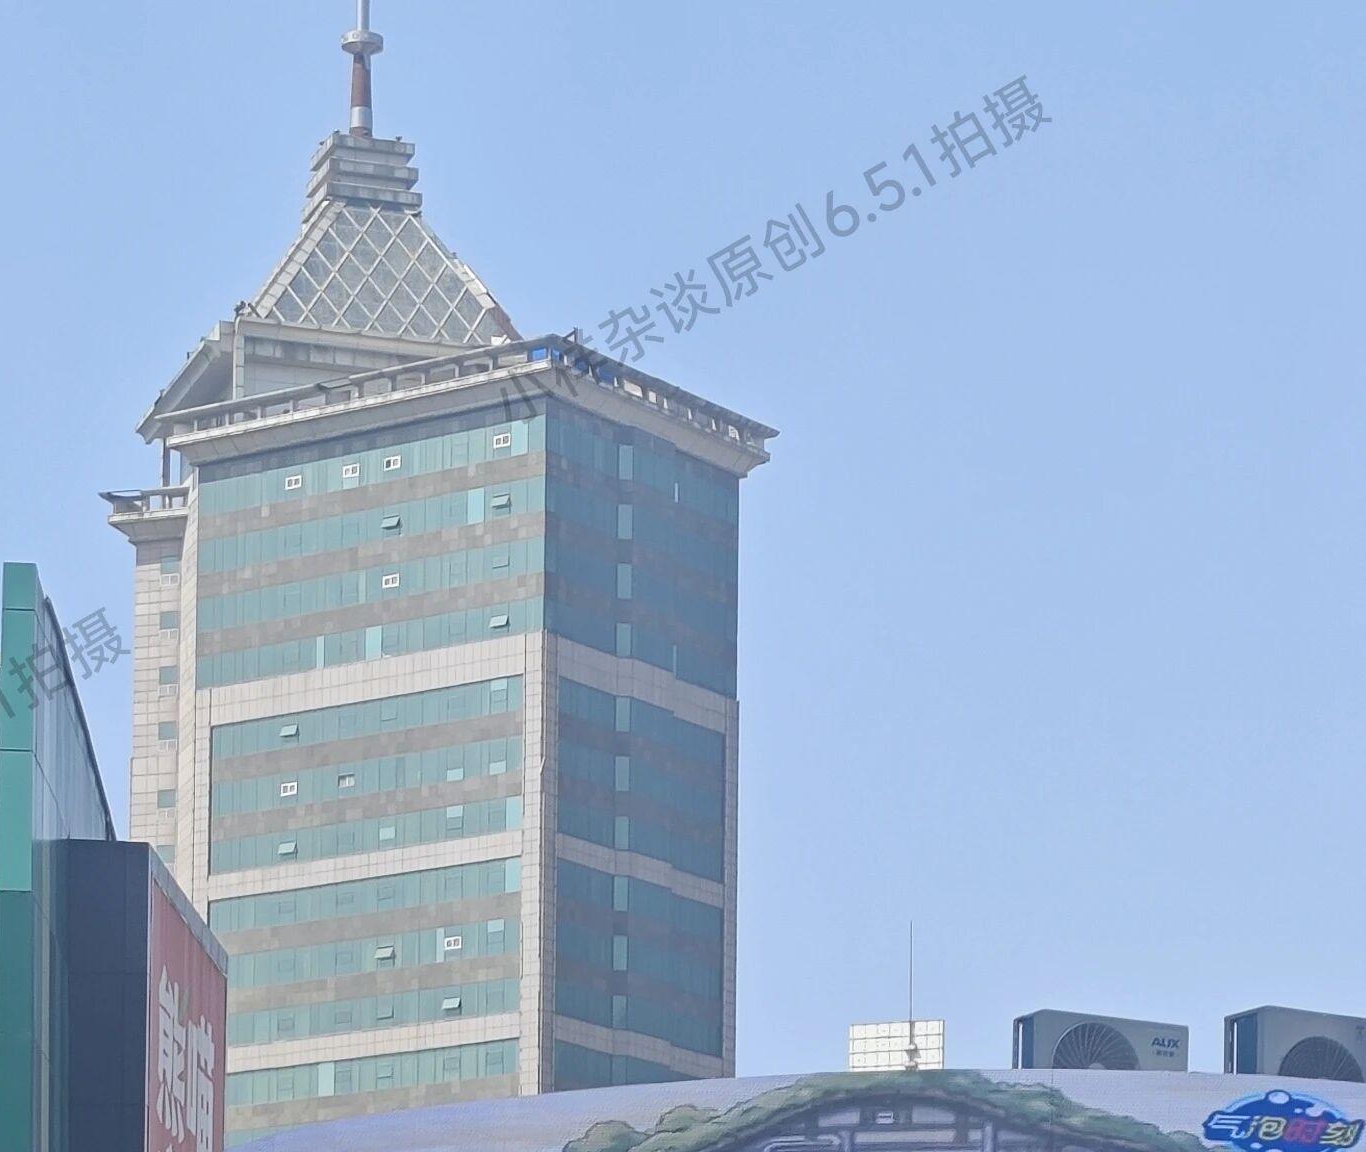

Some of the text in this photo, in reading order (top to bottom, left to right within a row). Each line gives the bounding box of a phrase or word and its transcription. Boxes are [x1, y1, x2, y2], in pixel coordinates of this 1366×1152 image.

[1151, 1036, 1181, 1049] AUX
[1208, 1113, 1359, 1148] 气泡时刻
